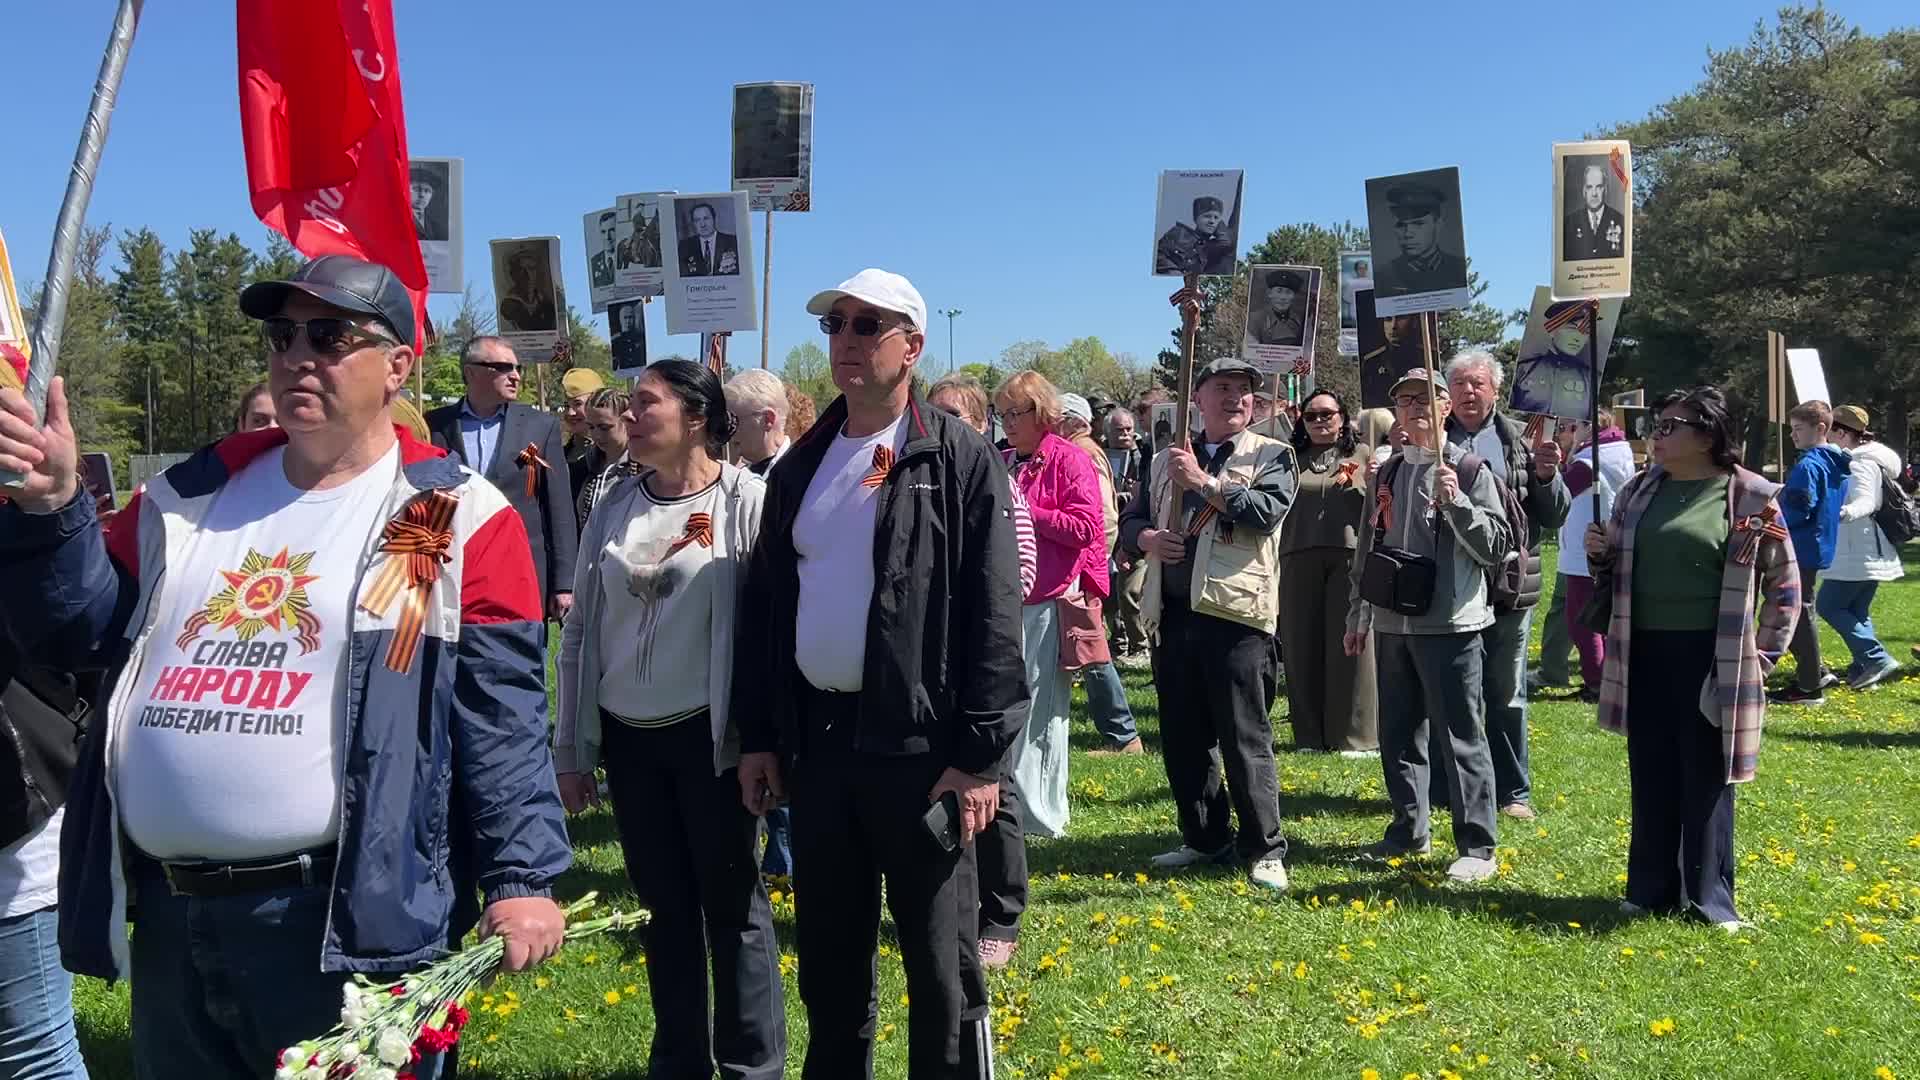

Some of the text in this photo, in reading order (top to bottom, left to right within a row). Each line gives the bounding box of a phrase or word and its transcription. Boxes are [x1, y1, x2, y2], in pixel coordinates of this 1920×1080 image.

[192, 639, 289, 668] СЛАВА
[150, 666, 313, 710] НАРОДУ
[138, 705, 304, 736] ПОБЕДИТЕЛЮ!
